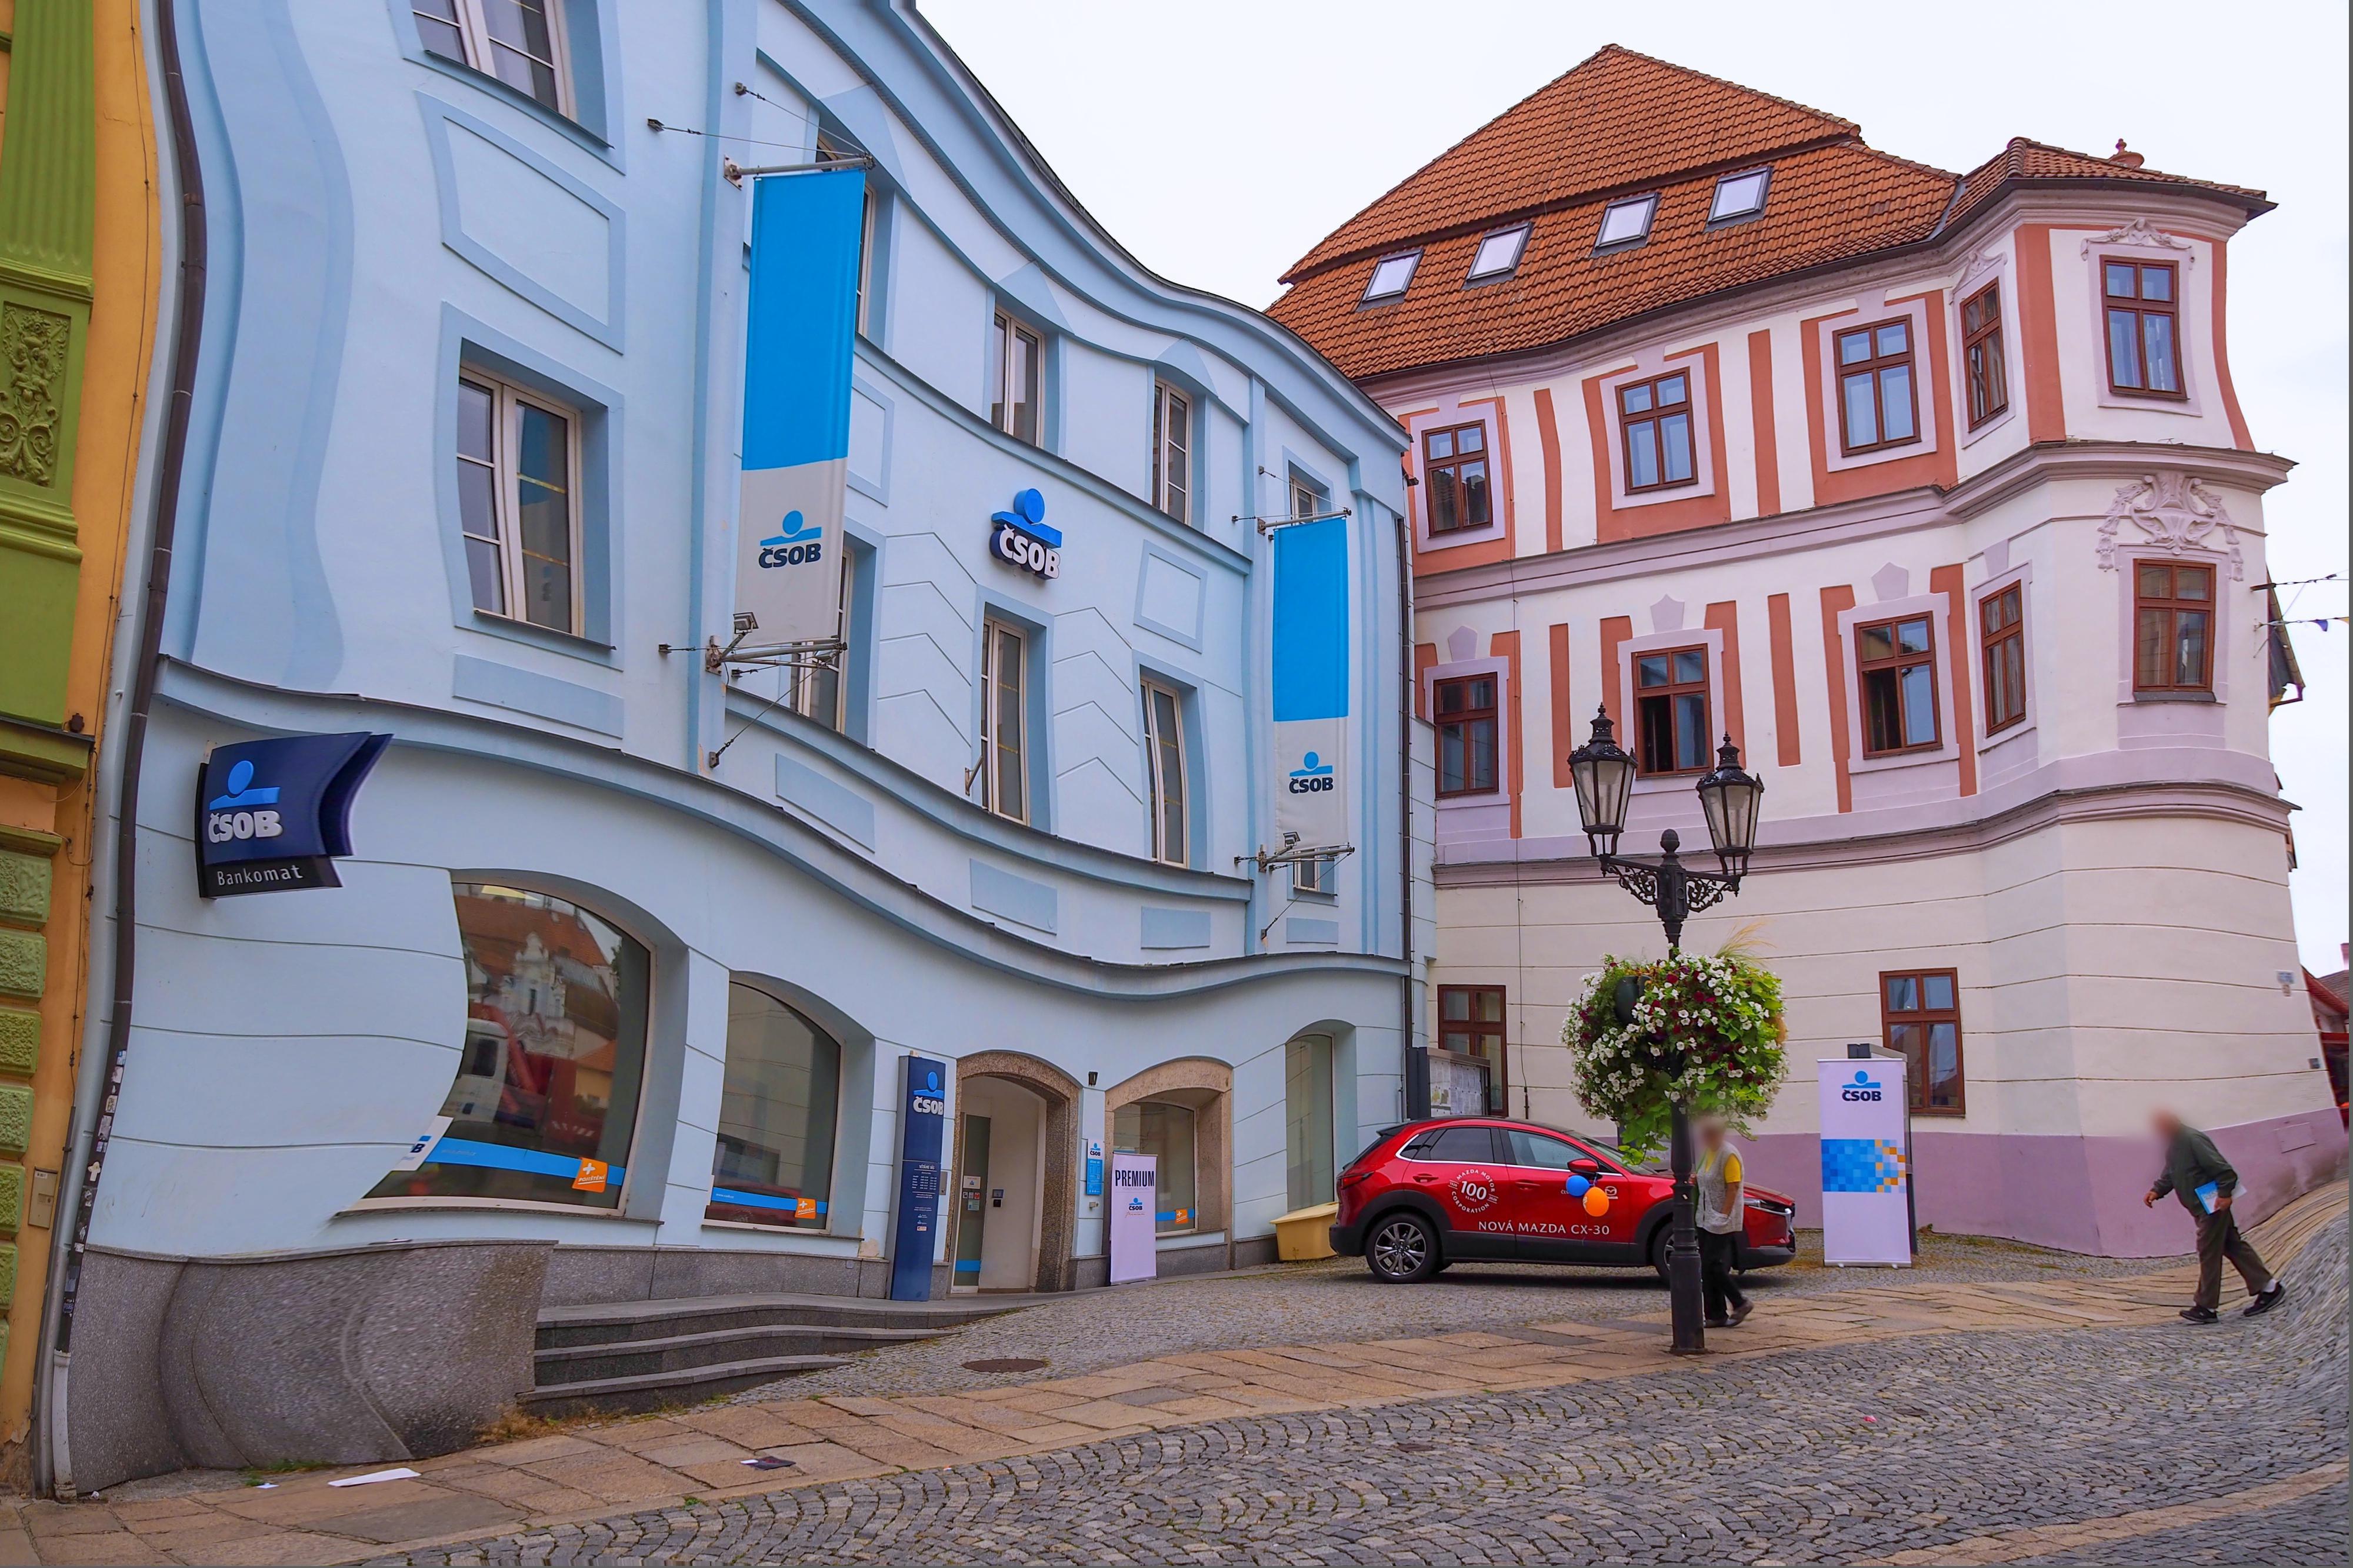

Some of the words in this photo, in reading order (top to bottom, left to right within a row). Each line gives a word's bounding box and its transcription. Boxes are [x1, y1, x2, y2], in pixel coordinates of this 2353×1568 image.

[758, 542, 821, 569] ČSOB
[999, 523, 1060, 579] ČSOB
[1289, 777, 1334, 794] ČSOB
[208, 810, 283, 843] ČSOB
[217, 865, 304, 886] Bankomat
[913, 1096, 944, 1115] ČSOB
[1842, 1089, 1881, 1102] ČSOB
[1115, 1169, 1155, 1187] PREMIUM
[1457, 1169, 1479, 1180] MAZDA
[1481, 1171, 1495, 1192] MOTOR
[1461, 1180, 1487, 1200] 100
[1451, 1191, 1490, 1213] CORPORATION
[1478, 1220, 1514, 1231] NOVÁ
[1518, 1222, 1566, 1233] MAZDA
[1571, 1224, 1610, 1235] CX-30
